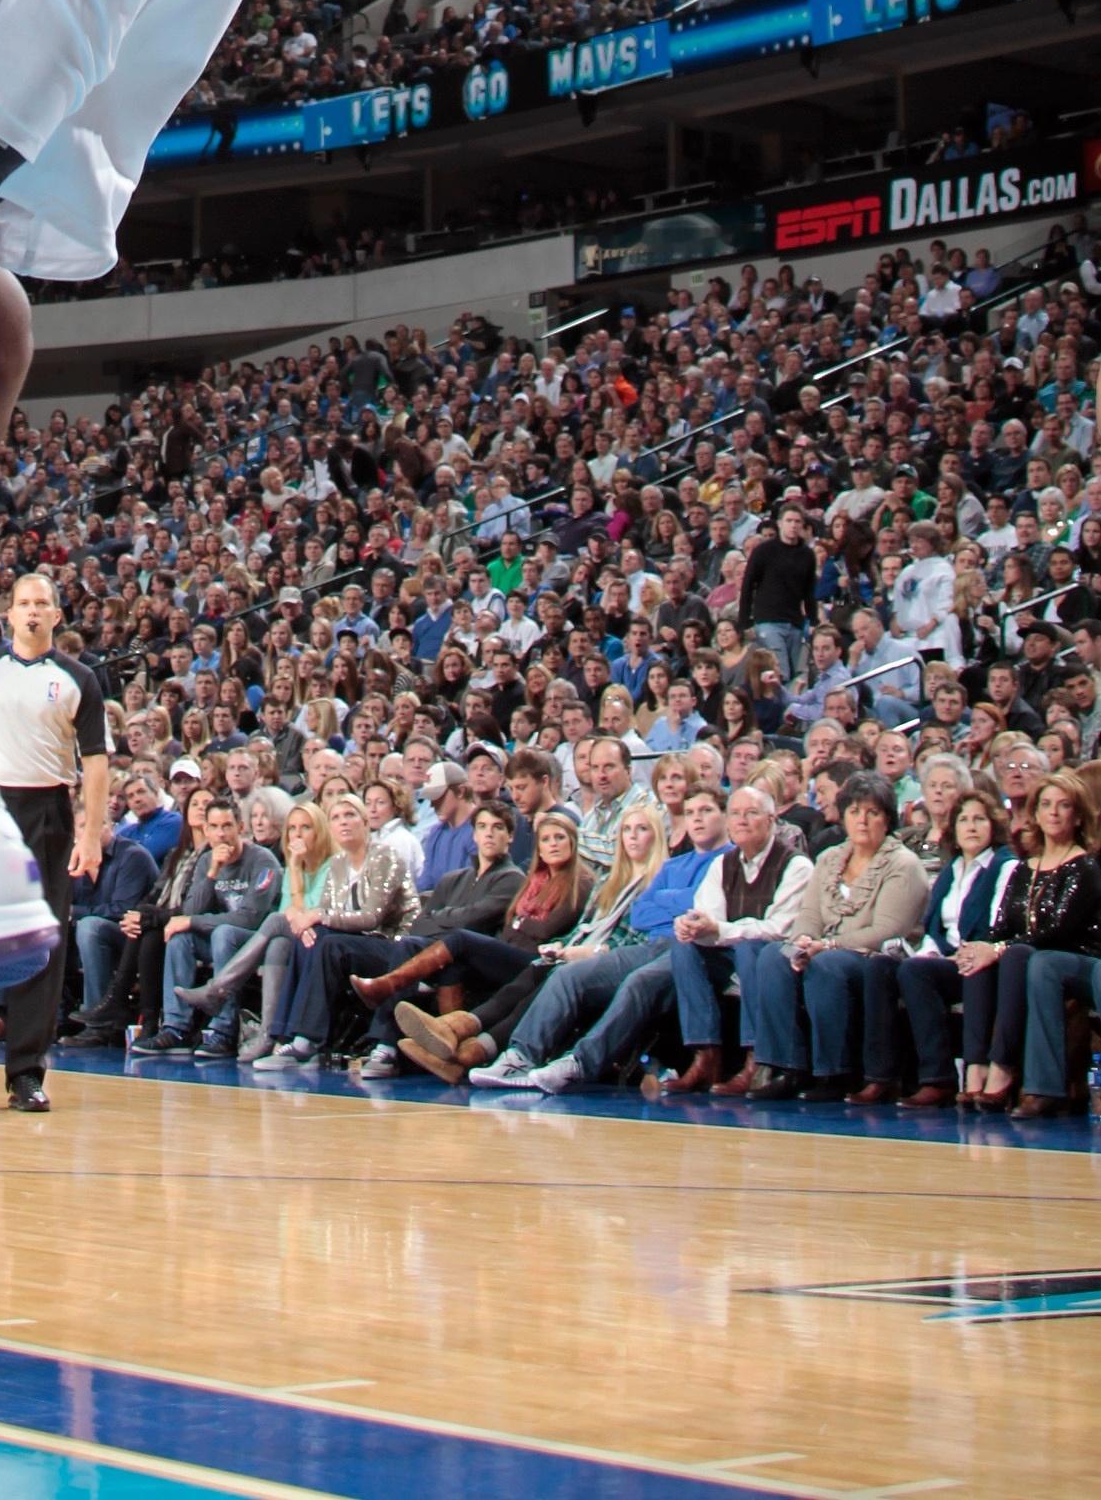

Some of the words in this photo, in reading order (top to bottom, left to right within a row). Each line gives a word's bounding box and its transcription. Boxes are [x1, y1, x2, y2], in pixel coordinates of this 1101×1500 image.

[352, 84, 431, 136] LETS
[464, 66, 509, 120] GO
[550, 35, 639, 97] MAVS
[776, 196, 882, 250] ESPN
